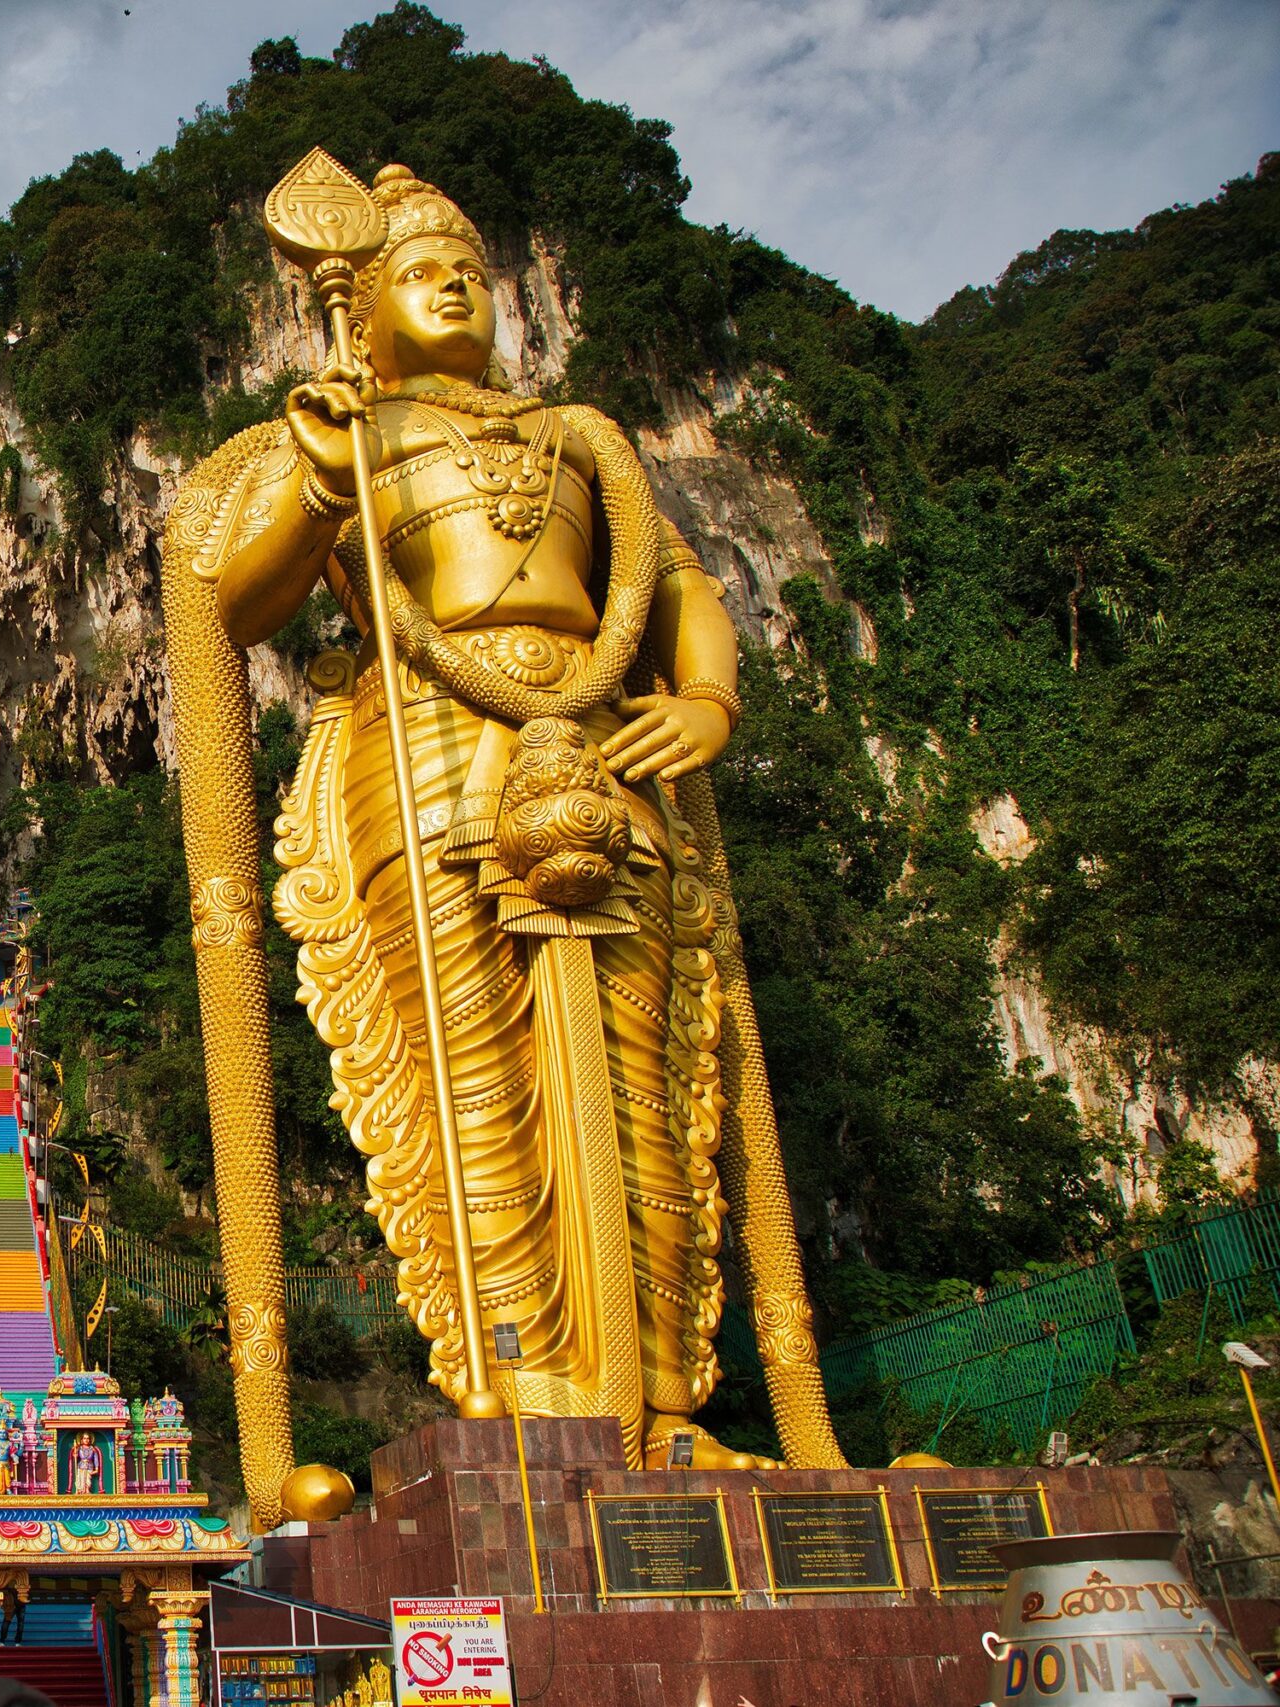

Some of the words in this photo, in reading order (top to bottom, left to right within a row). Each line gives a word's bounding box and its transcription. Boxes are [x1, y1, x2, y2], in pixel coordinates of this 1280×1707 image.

[396, 1601, 416, 1609] ANDA
[463, 1600, 497, 1608] KAWASAN
[408, 1639, 420, 1651] NO
[418, 1648, 449, 1678] SMOKING
